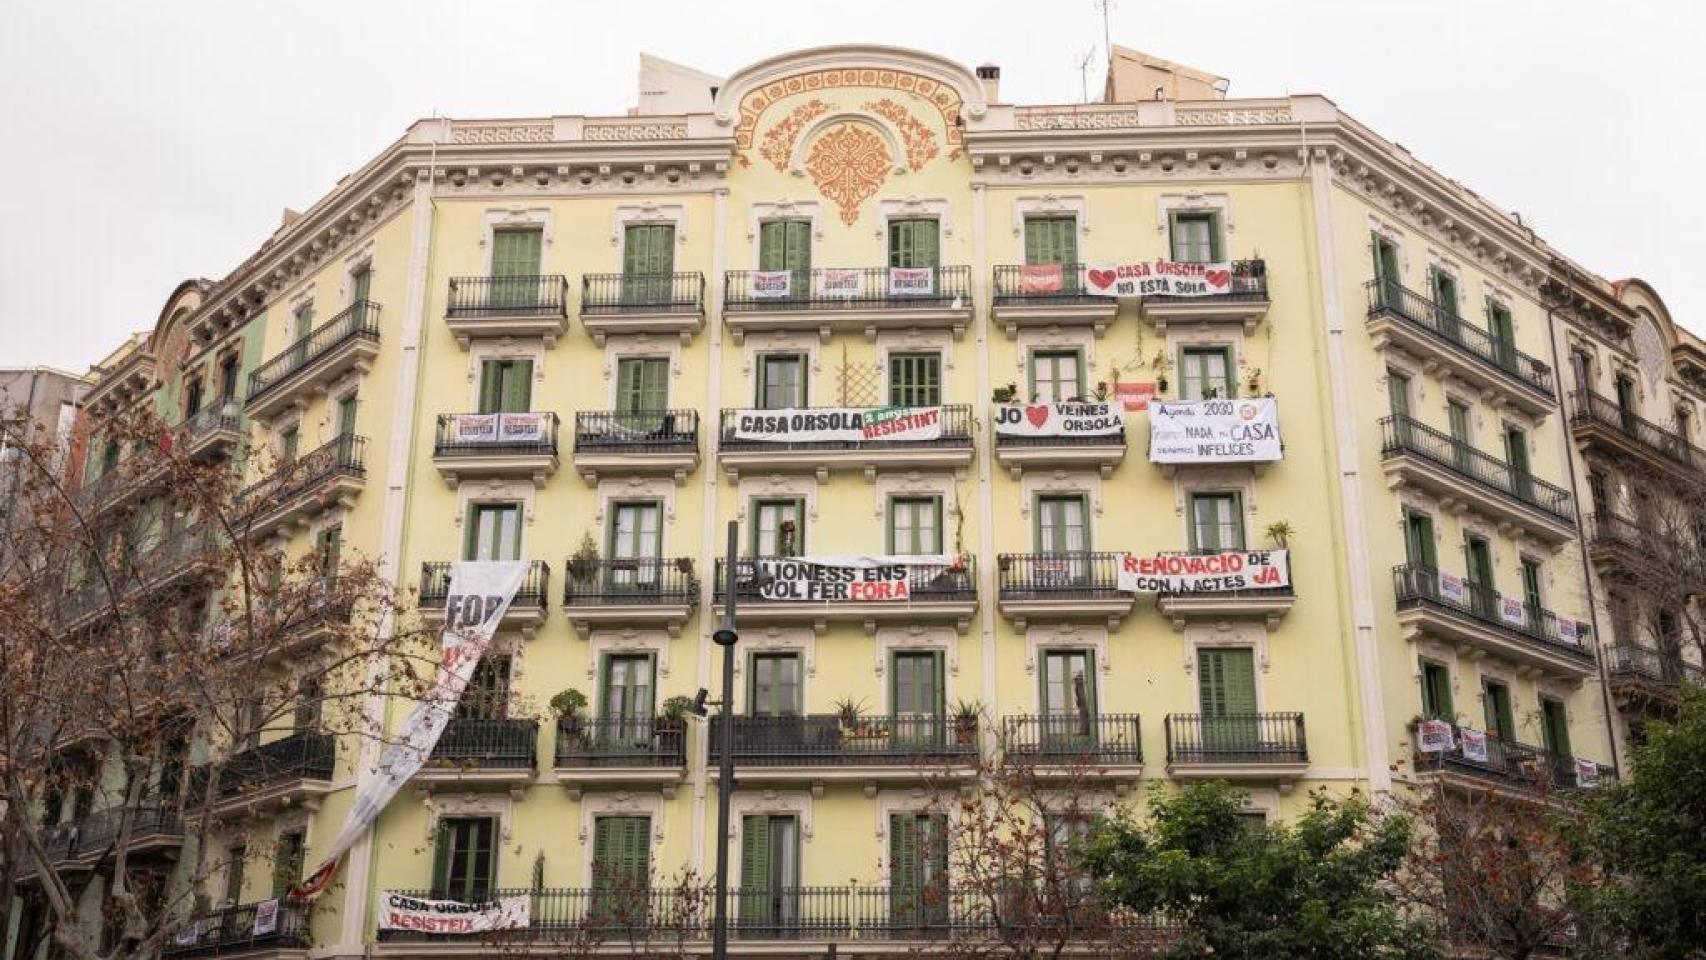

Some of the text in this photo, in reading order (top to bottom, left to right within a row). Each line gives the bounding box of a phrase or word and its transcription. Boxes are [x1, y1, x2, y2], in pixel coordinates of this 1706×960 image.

[1116, 261, 1150, 279] CASA
[1117, 280, 1135, 294] NO
[1175, 280, 1207, 294] SOLA
[995, 407, 1022, 424] JO
[1203, 402, 1234, 416] 2030
[741, 412, 863, 433] CASA ORSOLA
[863, 409, 939, 439] RESISTINT
[1185, 426, 1214, 439] NADA
[1230, 423, 1275, 441] CASA
[1197, 443, 1255, 456] INFELICES
[1248, 553, 1270, 566] DE
[863, 564, 908, 582] ENS
[1253, 566, 1281, 585] JA
[807, 581, 848, 600] FER
[850, 580, 908, 599] FORA
[389, 895, 429, 912] CASA
[389, 912, 474, 932] RESISTEIX
